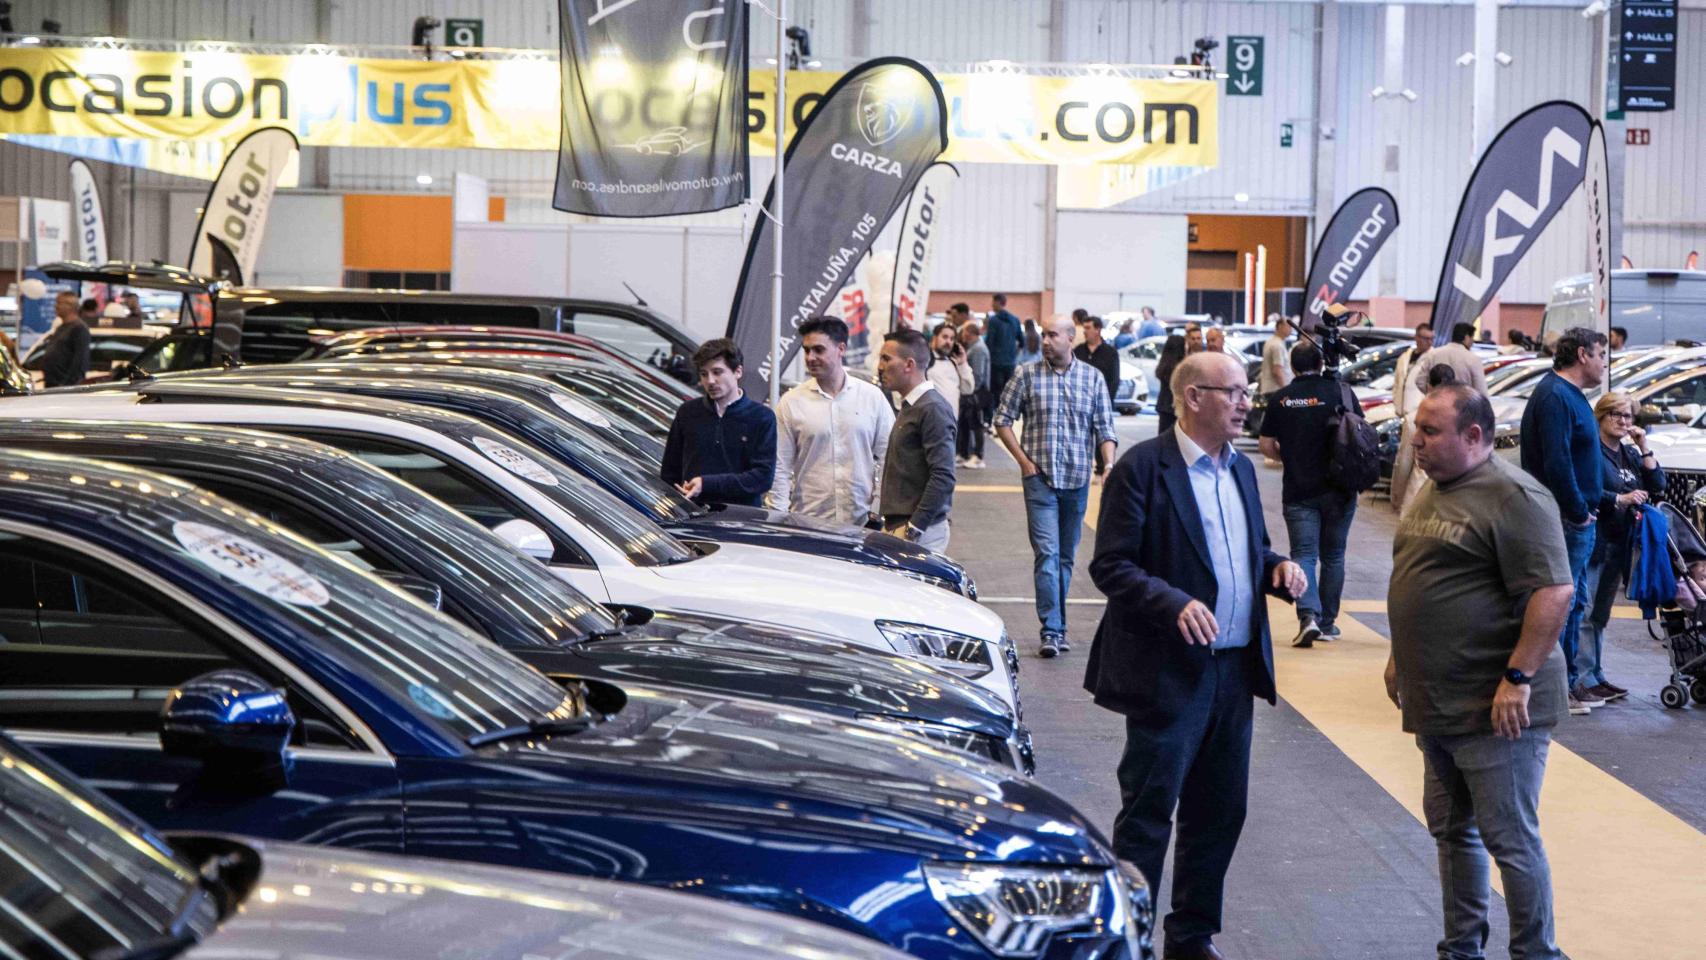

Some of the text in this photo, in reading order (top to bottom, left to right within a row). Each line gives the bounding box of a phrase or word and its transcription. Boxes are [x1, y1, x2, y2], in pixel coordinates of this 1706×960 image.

[1637, 8, 1664, 17] HALL
[454, 28, 475, 47] 9
[1637, 33, 1664, 42] HALL
[1235, 44, 1255, 71] 9
[831, 143, 903, 178] CARZA
[222, 152, 269, 254] otor
[851, 213, 877, 244] 105
[906, 185, 937, 295] motor
